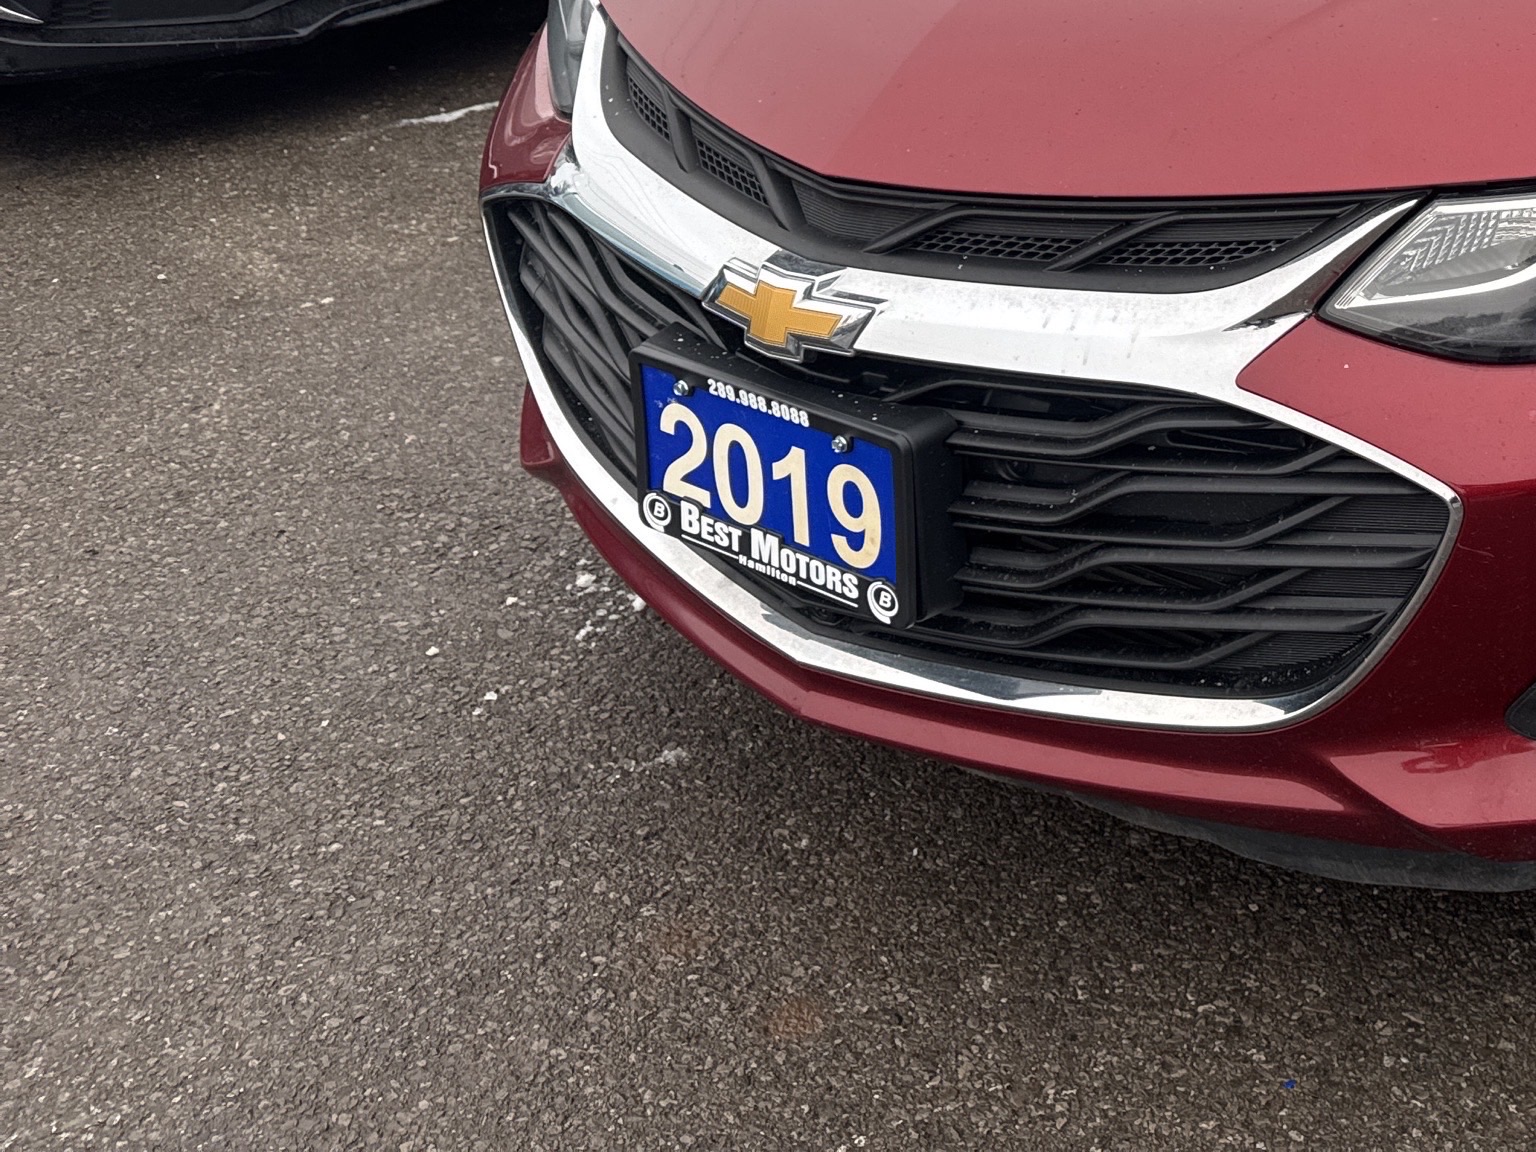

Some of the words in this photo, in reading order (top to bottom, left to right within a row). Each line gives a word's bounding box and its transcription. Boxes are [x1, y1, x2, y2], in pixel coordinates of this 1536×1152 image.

[706, 378, 810, 428] 289.988.8088
[659, 402, 882, 570] 2019
[680, 499, 742, 552] BEST
[750, 527, 860, 599] MOTORS
[738, 554, 797, 586] Hamilton
